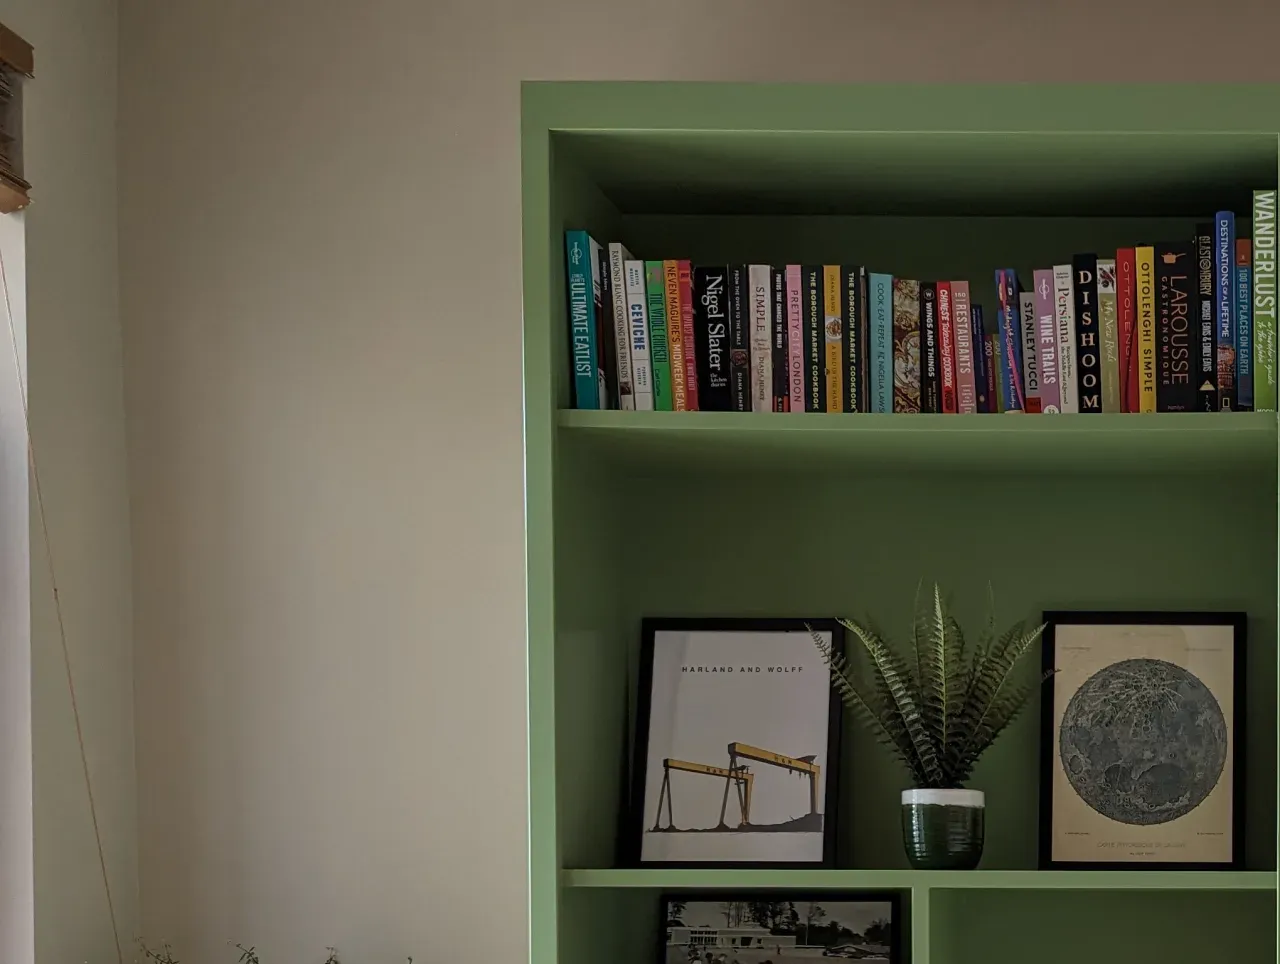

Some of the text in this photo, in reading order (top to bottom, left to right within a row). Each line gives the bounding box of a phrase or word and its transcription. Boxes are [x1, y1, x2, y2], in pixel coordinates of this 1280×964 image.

[612, 250, 620, 282] RAYMOND
[1198, 236, 1212, 296] GLASTONBURY
[1220, 220, 1229, 285] DESTINATIONS
[1255, 192, 1275, 319] WANDERLUST
[614, 284, 623, 304] BLANC
[667, 266, 678, 295] NEVEN
[1223, 287, 1228, 295] OF
[571, 283, 589, 333] ULTIMATE
[615, 306, 625, 336] COOKING
[669, 297, 680, 343] MAGUIRE'S
[701, 275, 726, 371] Nigel Slater
[755, 287, 765, 332] SIMPLE
[926, 302, 934, 328] WINGS
[940, 289, 949, 321] CHINESE
[1058, 288, 1071, 343] Persiana
[1101, 300, 1113, 316] My
[1202, 300, 1210, 321] MICHAEL
[1221, 302, 1230, 338] LIFETIME
[1239, 269, 1248, 374] 100 BEST PLACES ON EARTH
[631, 304, 645, 350] CEVICHE
[650, 293, 667, 363] THE WHOLE CHICKEN
[941, 322, 951, 356] Takeaway
[956, 304, 970, 374] RESTAURANTS
[1025, 303, 1035, 351] STANLEY
[1078, 270, 1099, 408] DISHOOM
[1104, 318, 1114, 338] New
[1141, 262, 1152, 392] OTTOLENGHI SIMPLE
[1170, 276, 1188, 385] LAROUSSE
[1256, 321, 1264, 329] to
[1257, 330, 1266, 342] the
[574, 336, 591, 377] EATLIST
[620, 352, 628, 378] FRIENDS
[673, 344, 682, 384] MIDWEEK
[985, 341, 993, 356] 200
[1040, 315, 1056, 384] WINE TRAILS
[1202, 343, 1211, 357] EMILY
[943, 357, 953, 388] COOKBOOK
[1028, 355, 1037, 390] TUCCI
